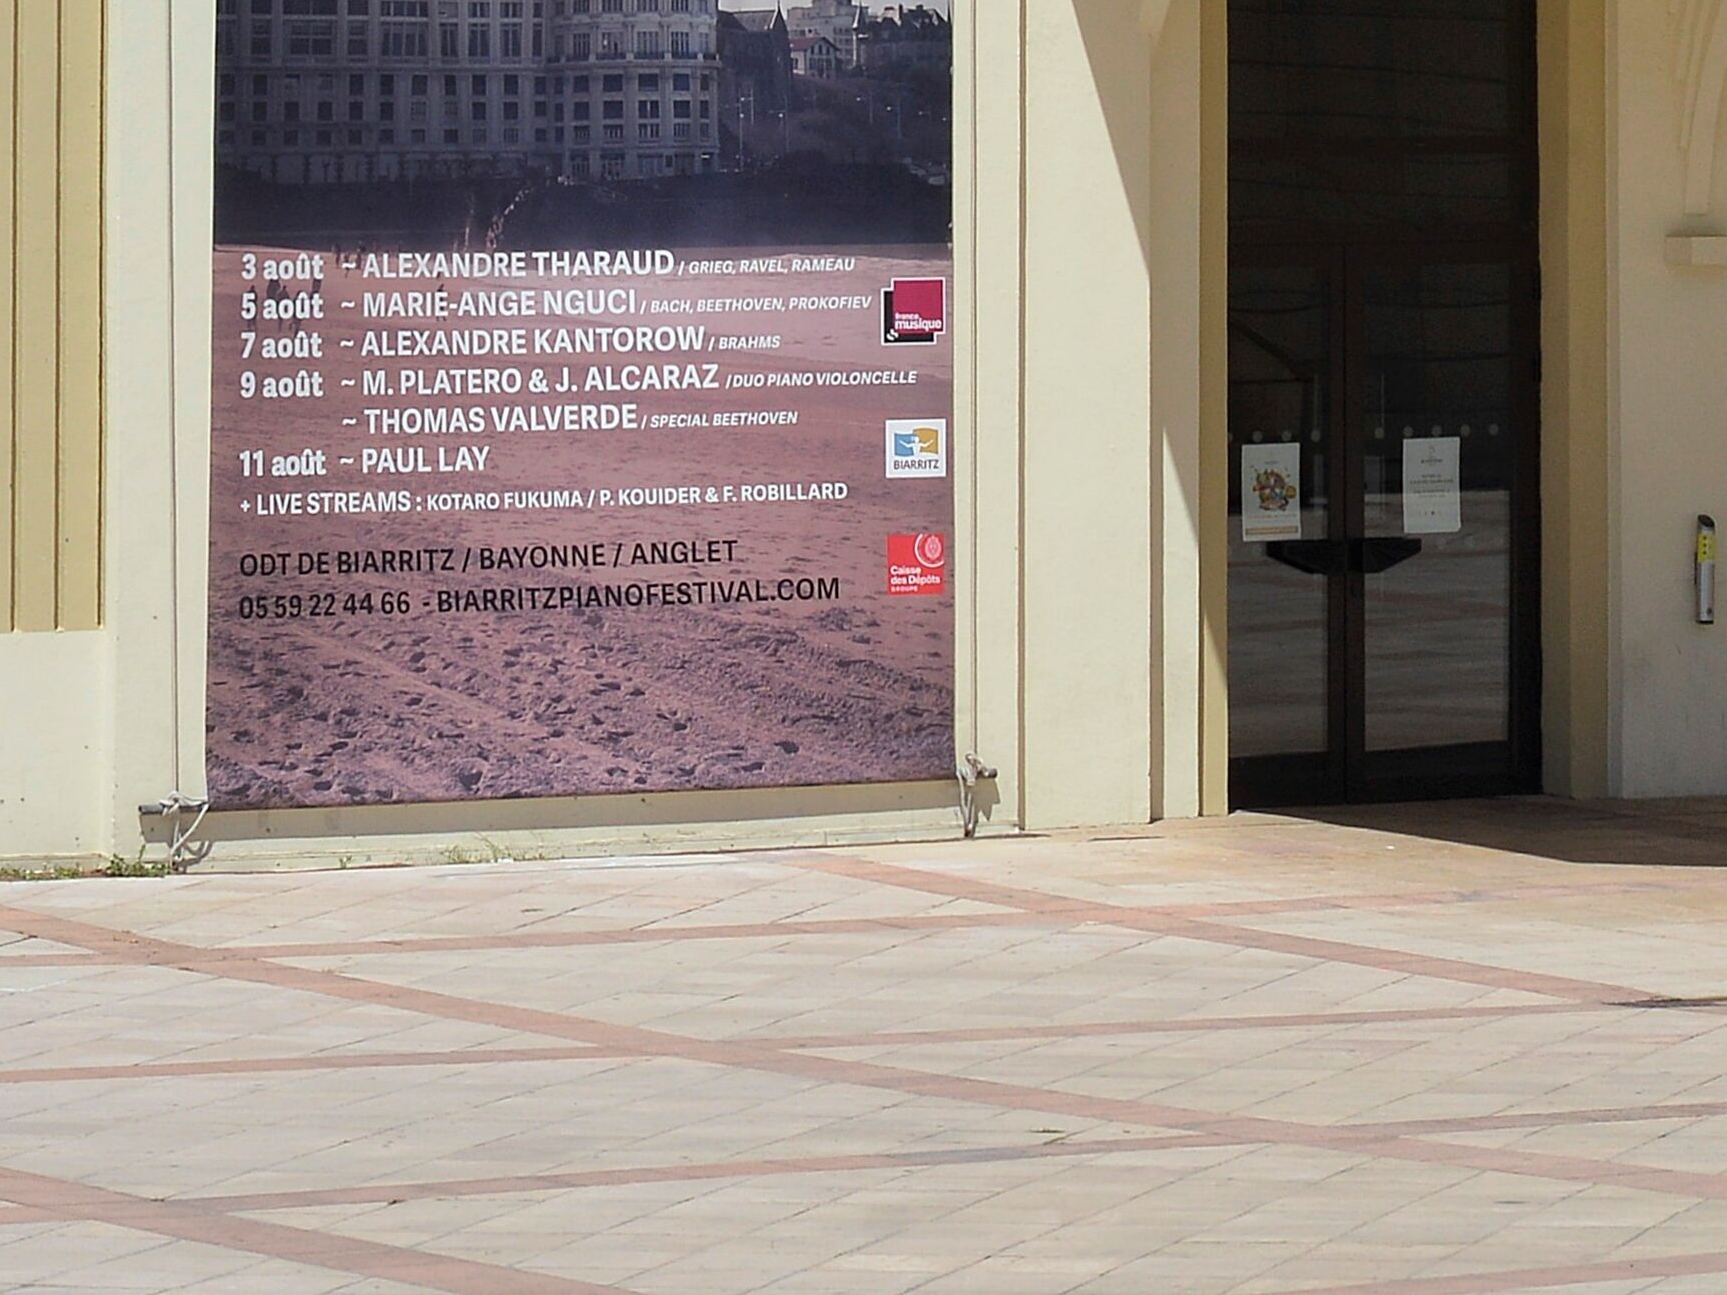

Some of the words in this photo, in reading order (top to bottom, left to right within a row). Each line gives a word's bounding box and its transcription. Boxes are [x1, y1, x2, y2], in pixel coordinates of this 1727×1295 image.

[242, 253, 256, 279] 3
[264, 254, 324, 279] août
[363, 252, 526, 278] ALEXANDRE
[533, 250, 675, 277] THARAUD
[689, 260, 737, 275] GRIEG,
[740, 259, 787, 274] RAVEL,
[791, 258, 855, 271] RAMEAU
[241, 293, 255, 319] 5
[262, 292, 324, 319] août
[364, 290, 535, 317] MARIE-ANGE
[543, 289, 636, 315] NGUCI
[650, 300, 693, 314] BACH,
[697, 299, 786, 313] BEETHOVEN,
[789, 296, 871, 309] PROKOFIEV
[895, 318, 942, 332] musique
[241, 333, 255, 358] 7
[261, 331, 323, 358] août
[361, 330, 526, 356] ALEXANDRE
[534, 326, 705, 355] KANTOROW
[719, 336, 781, 349] BRAHMS
[241, 372, 255, 398] 9
[262, 371, 324, 397] août
[364, 371, 394, 395] M.
[401, 369, 521, 394] PLATERO
[529, 369, 548, 393] &
[556, 367, 577, 392] J.
[585, 364, 719, 391] ALCARAZ
[768, 373, 813, 387] PIANO
[817, 371, 917, 386] VIOLONCELLE
[365, 408, 484, 434] THOMAS
[491, 404, 638, 431] VALVERDE
[650, 415, 709, 429] SPECIAL
[713, 412, 798, 426] BEETHOVEN
[240, 450, 263, 476] 11
[272, 449, 326, 476] août
[362, 447, 431, 474] PAUL
[439, 446, 490, 472] LAY
[894, 459, 939, 470] BIARRITZ
[257, 494, 302, 515] LIVE
[307, 491, 411, 513] STREAMS
[427, 493, 499, 510] KOTARO
[505, 490, 583, 508] FUKUMA
[600, 490, 615, 506] P.
[619, 487, 701, 504] KOUIDER
[705, 487, 719, 502] &
[723, 486, 738, 502] F.
[741, 483, 848, 501] ROBILLARD
[240, 553, 291, 577] ODT
[298, 552, 330, 575] DE
[337, 548, 455, 574] BIARRITZ
[479, 543, 606, 570] BAYONNE
[630, 540, 738, 565] ANGLET
[890, 565, 921, 575] Caisse
[891, 576, 907, 585] des
[240, 595, 269, 619] 05
[274, 594, 302, 618] 59
[309, 593, 335, 617] 22
[342, 592, 373, 615] 44
[381, 591, 410, 615] 66
[437, 577, 840, 613] BIARRITZPIANOFESTIVAL.COM
